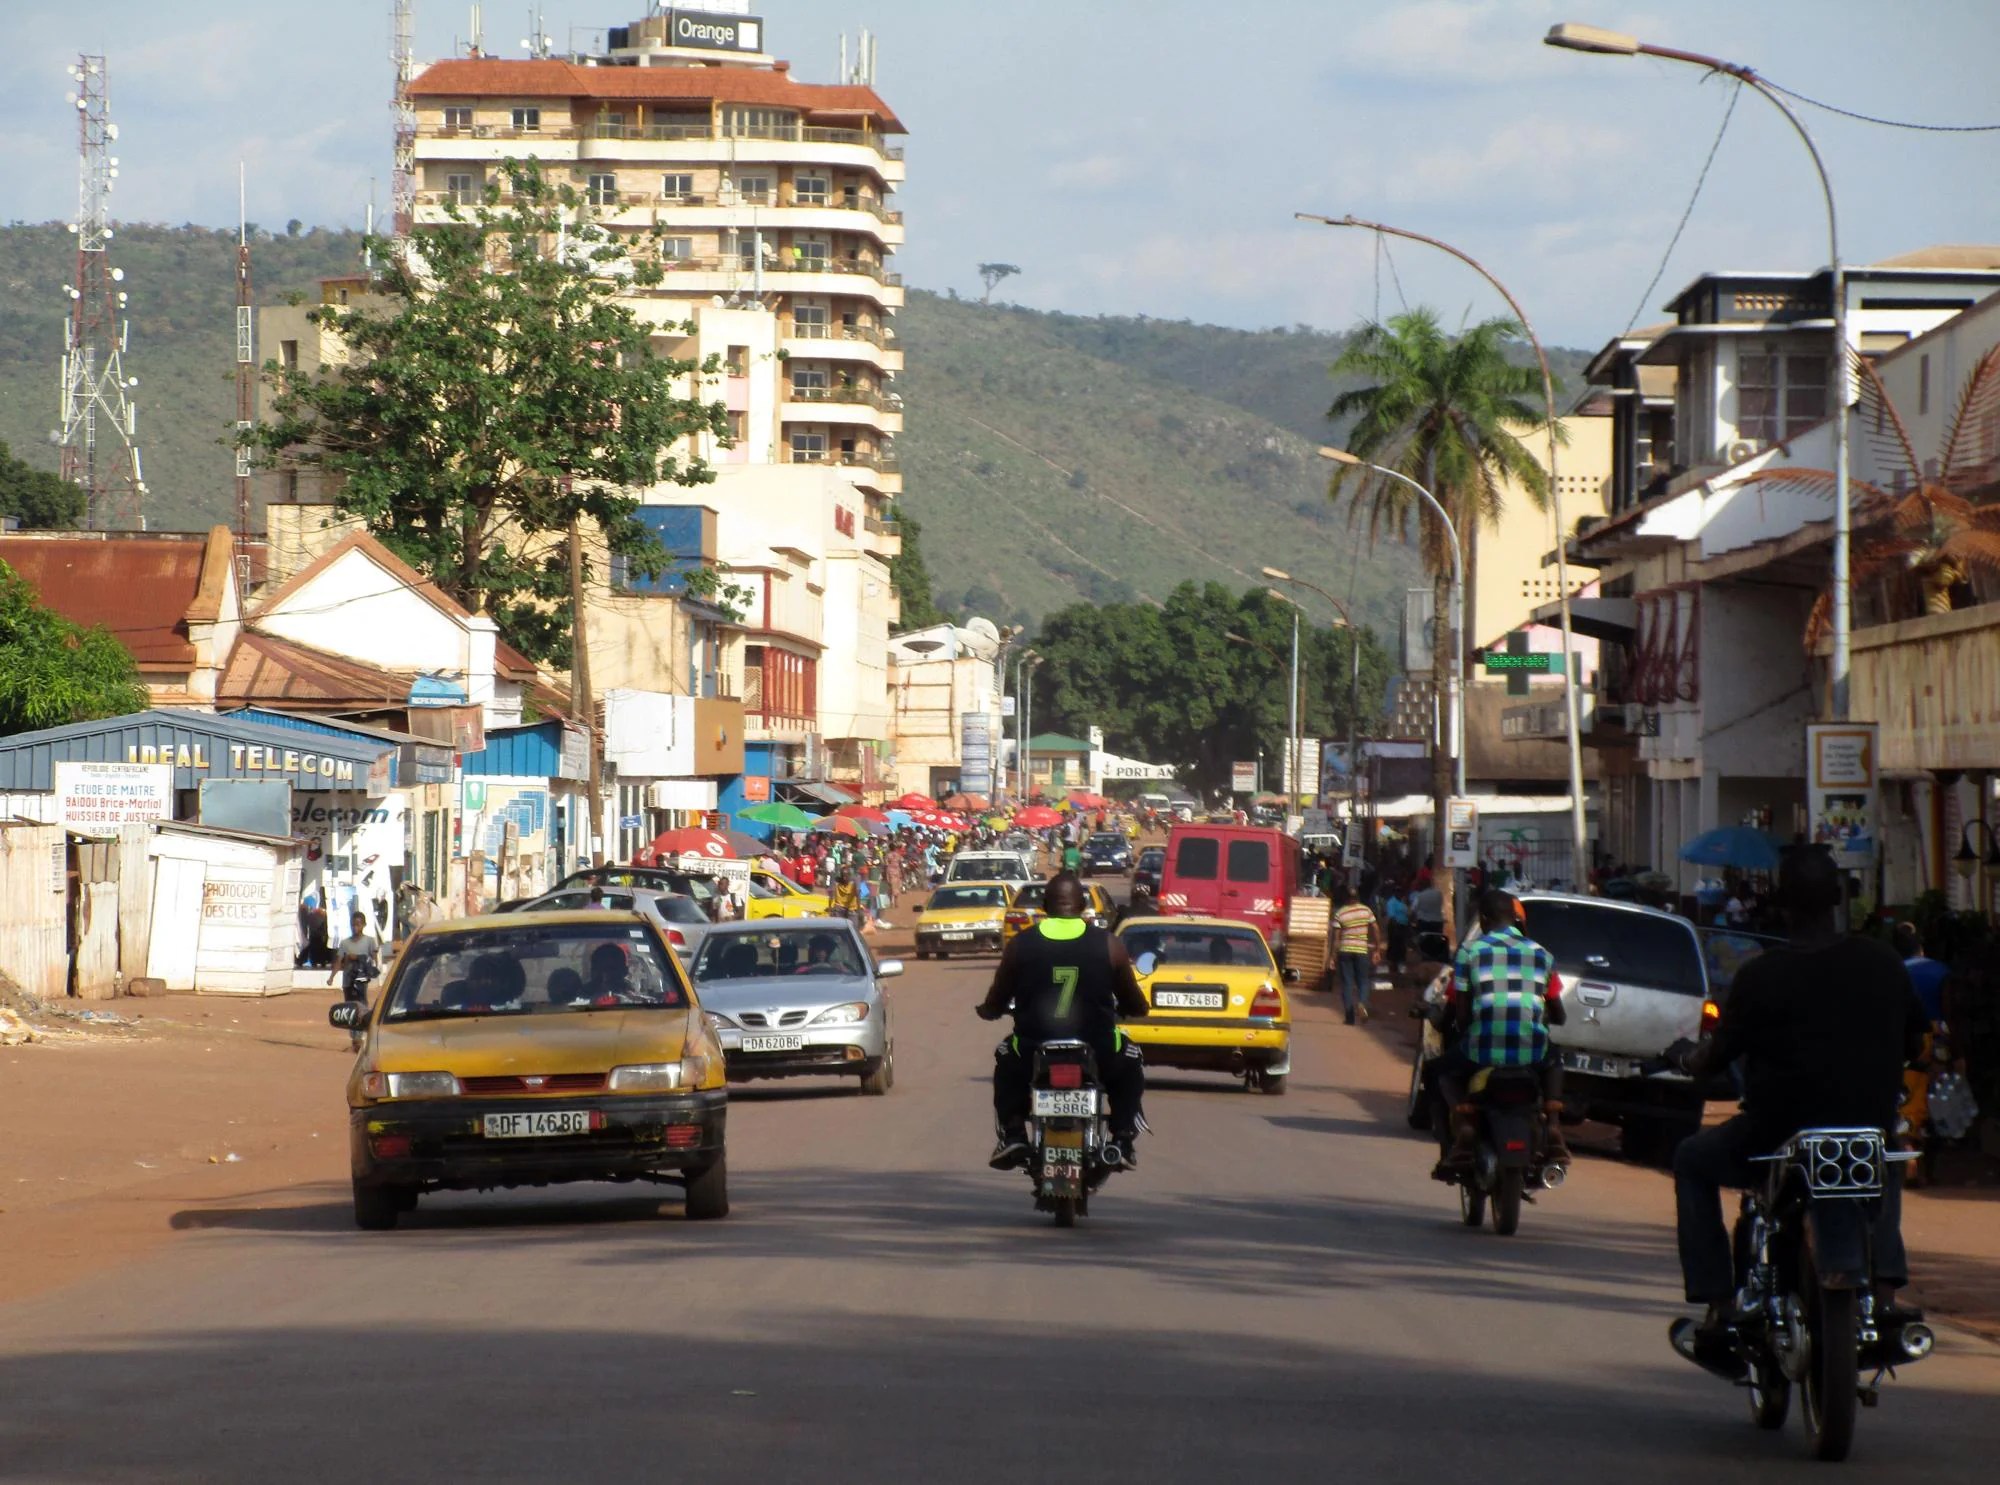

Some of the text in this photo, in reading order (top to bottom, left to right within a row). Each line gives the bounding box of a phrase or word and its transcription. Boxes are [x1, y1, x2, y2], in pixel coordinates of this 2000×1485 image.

[679, 18, 734, 45] Orange
[128, 744, 353, 781] IDEAL TELECOM
[1117, 767, 1151, 777] PORT
[74, 784, 155, 796] ETUDE DE MAITRE
[66, 811, 161, 822] HUISSIER DE JUSTICE
[206, 883, 267, 898] PHOTOCOPIE
[205, 904, 257, 919] DES CLES
[1052, 966, 1079, 1018] 7
